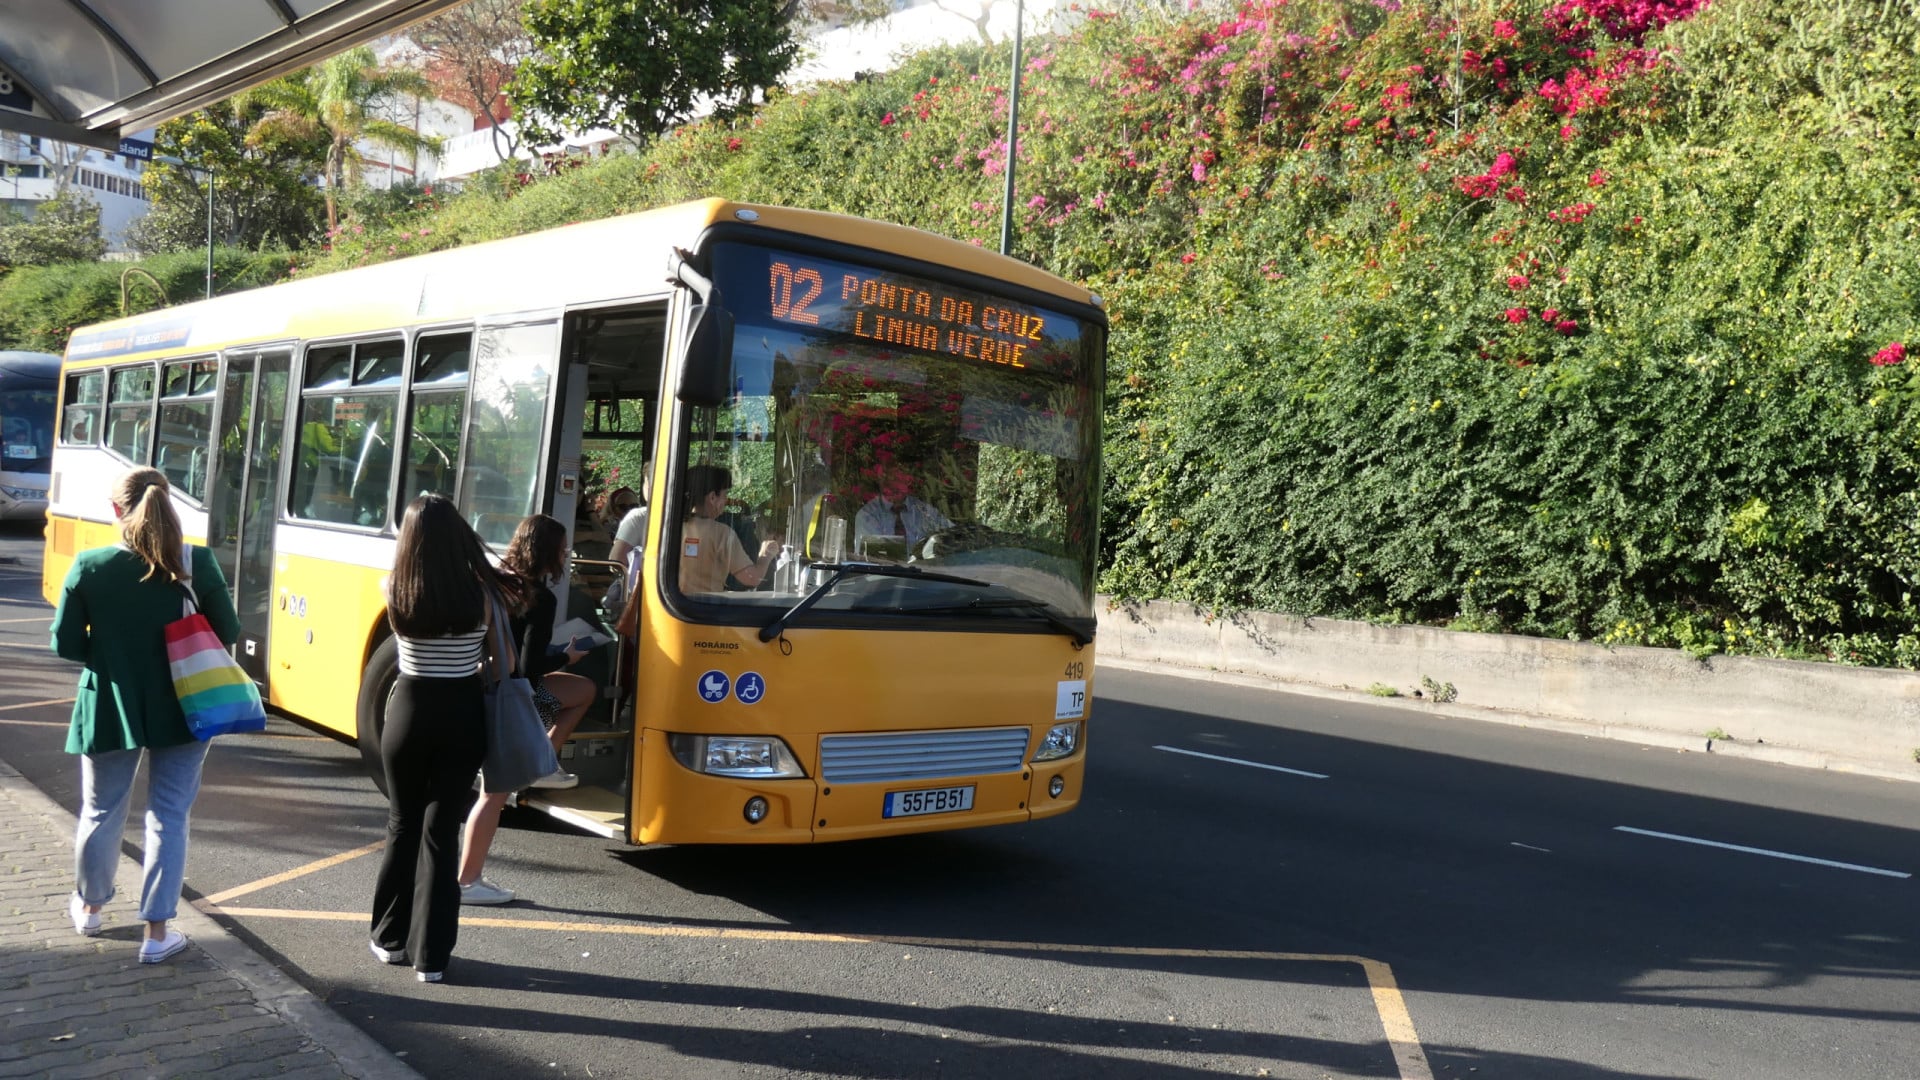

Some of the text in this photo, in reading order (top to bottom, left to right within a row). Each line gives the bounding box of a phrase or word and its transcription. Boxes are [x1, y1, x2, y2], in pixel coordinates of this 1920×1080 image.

[770, 262, 1045, 341] 02 PONTA DA CRUZ
[855, 312, 1028, 368] LINHA VERDE
[694, 641, 739, 650] HORÁRIOS
[1064, 661, 1084, 679] 419
[1072, 692, 1084, 708] TP
[903, 790, 964, 813] 55FB51
